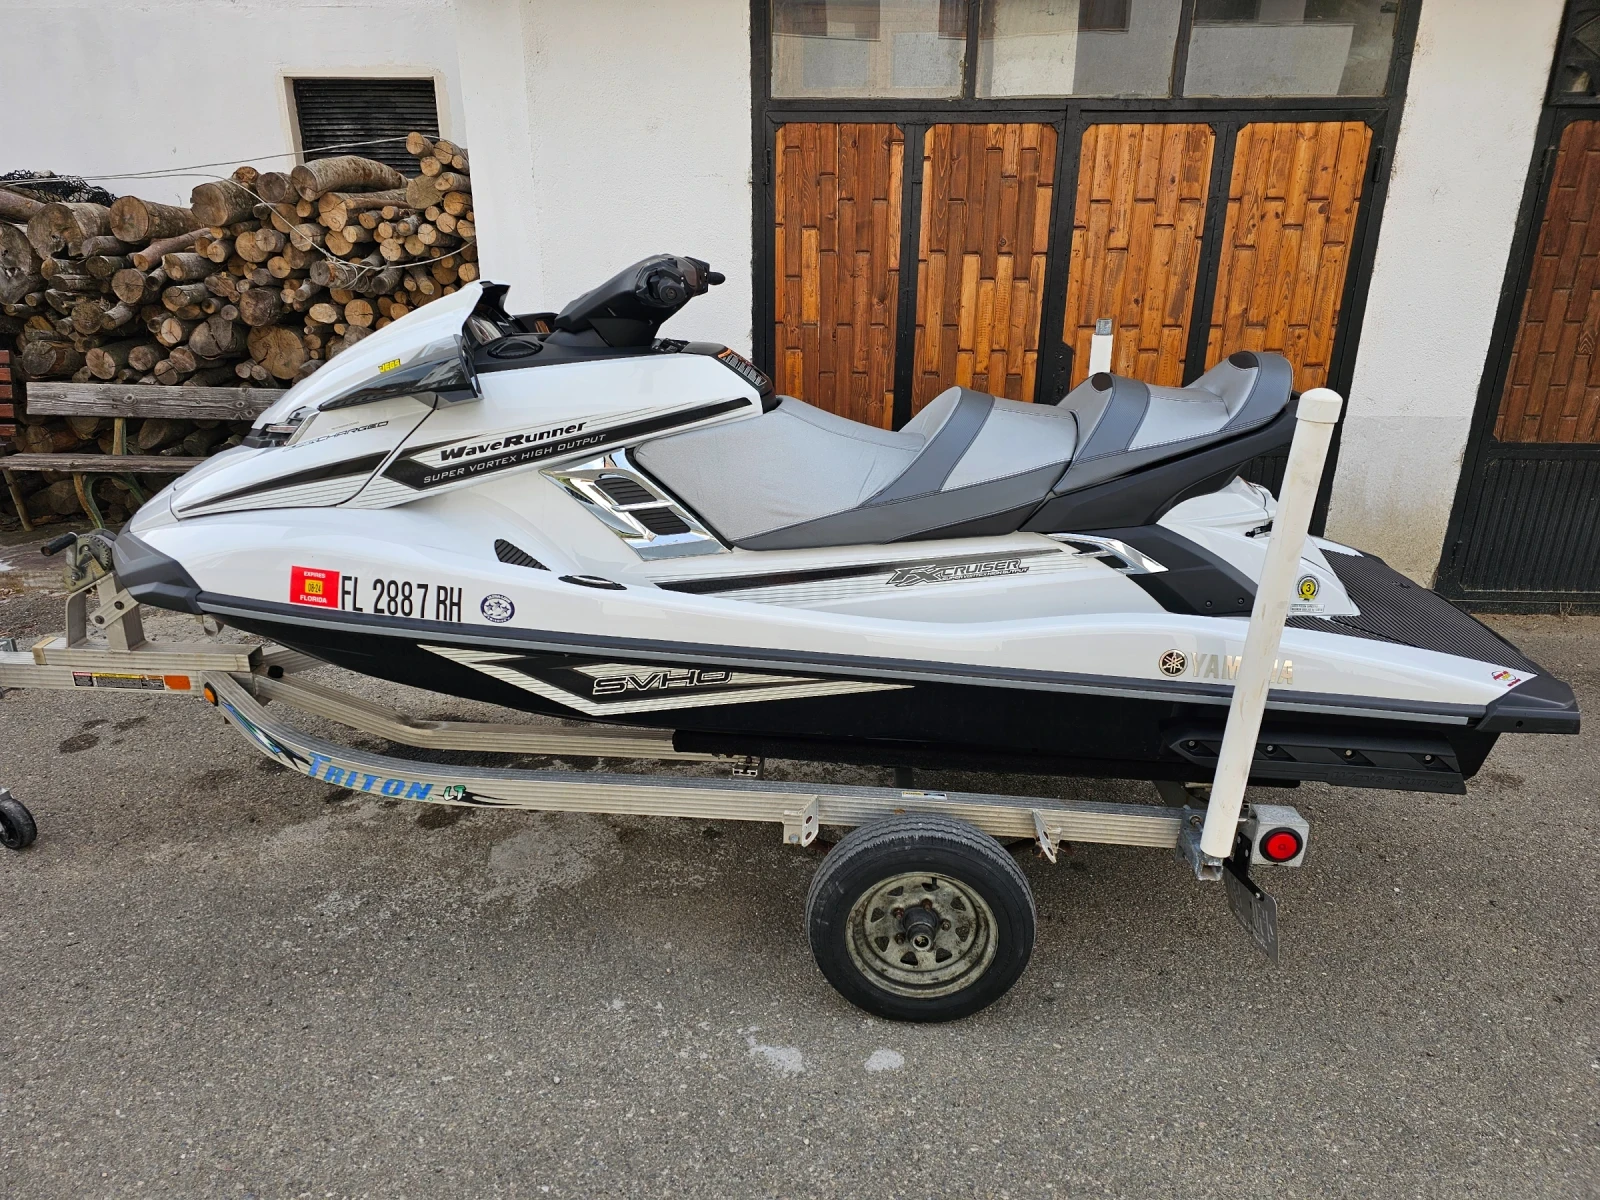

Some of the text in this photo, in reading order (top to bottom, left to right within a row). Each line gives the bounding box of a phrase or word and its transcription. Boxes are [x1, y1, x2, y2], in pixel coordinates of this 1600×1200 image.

[440, 421, 587, 461] WaveRunner
[423, 434, 606, 484] SUPER VORTEX HIGH OUTPUT
[303, 571, 326, 579] EXPIRES
[942, 560, 1021, 576] CRUISER
[299, 594, 328, 604] FLORIDA
[341, 575, 463, 622] FL 2887 RH
[1305, 583, 1312, 592] 3
[592, 669, 733, 695] SVHO
[1191, 652, 1294, 685] YAMA
[308, 751, 467, 801] TRITON LT
